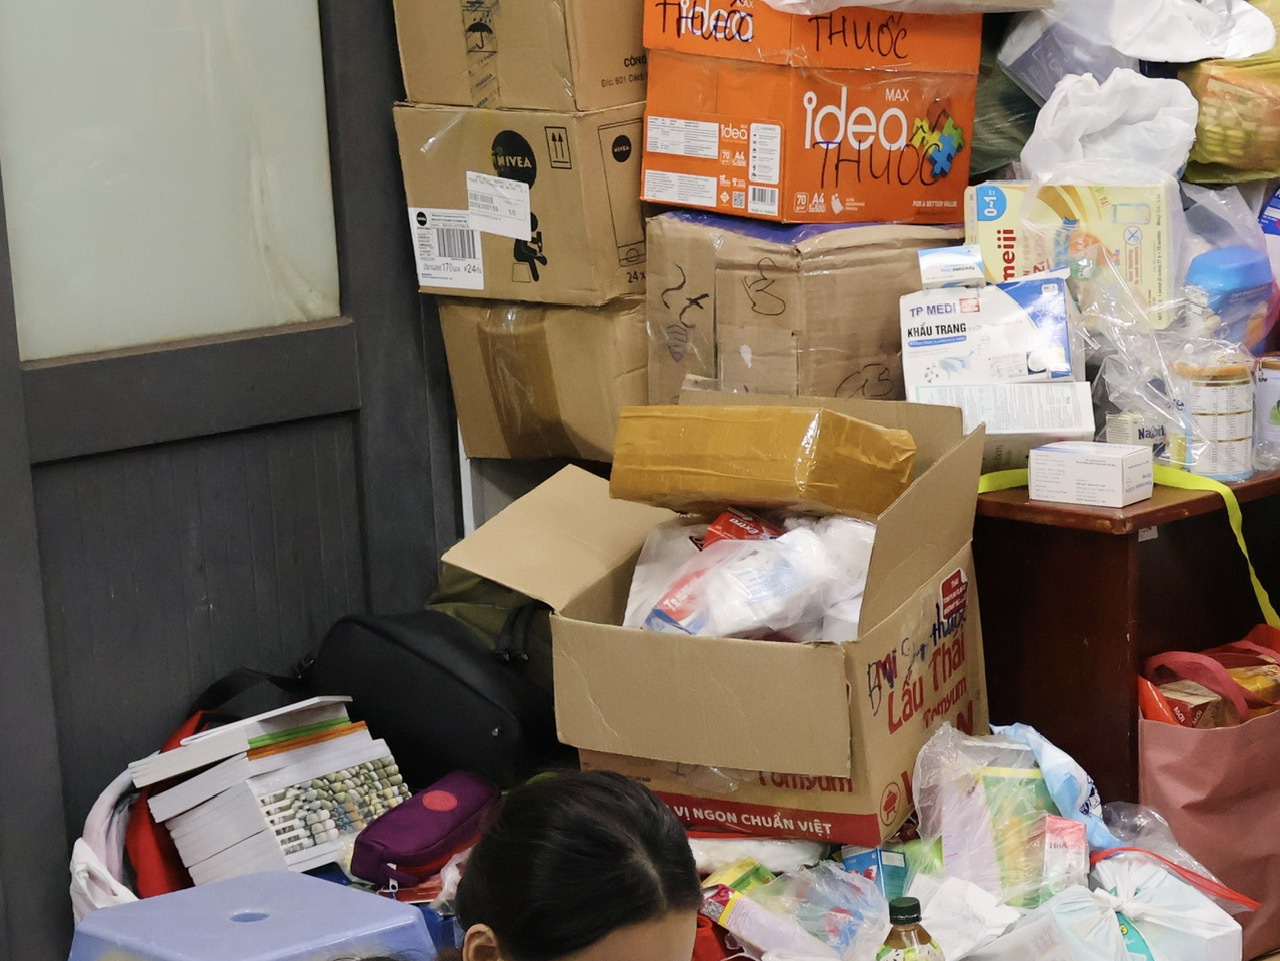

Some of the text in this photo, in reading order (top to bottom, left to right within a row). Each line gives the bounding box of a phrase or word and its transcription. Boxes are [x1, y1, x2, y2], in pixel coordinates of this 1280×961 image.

[885, 88, 909, 101] MAX
[803, 86, 908, 151] idea
[496, 155, 533, 169] NIVEA
[812, 193, 825, 204] A4
[907, 321, 967, 338] KHẨU TRANG
[675, 805, 833, 838] VỊ NGON CHUẨN VIỆT
